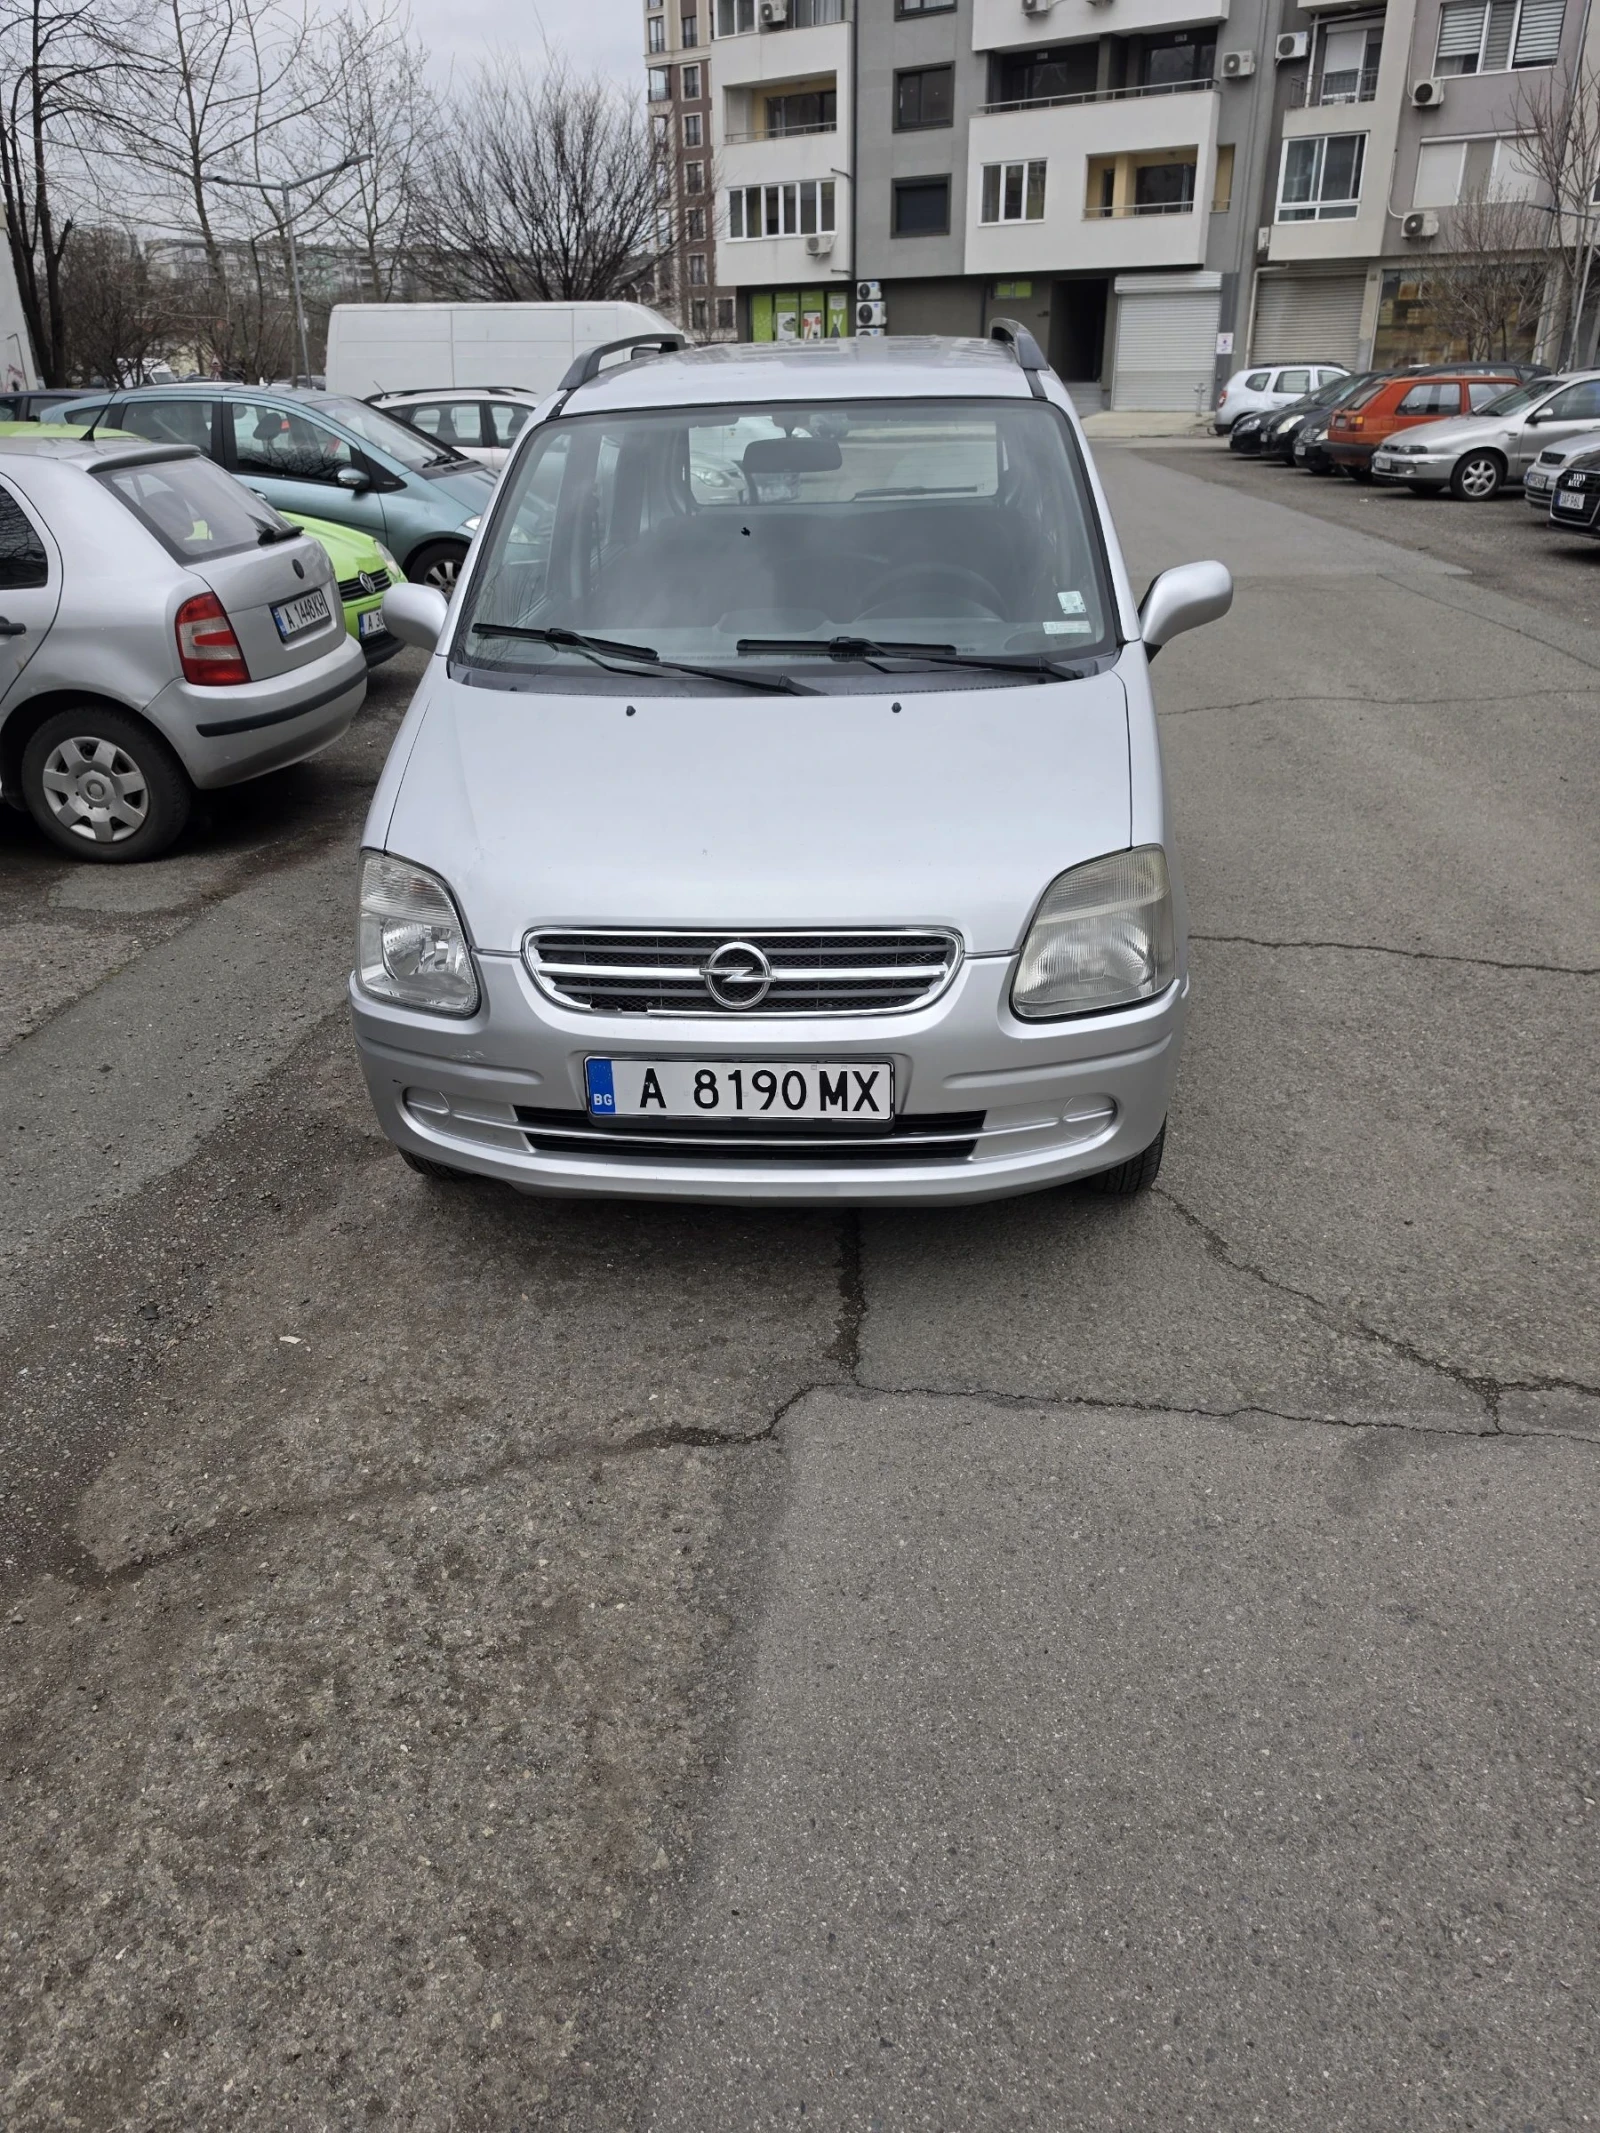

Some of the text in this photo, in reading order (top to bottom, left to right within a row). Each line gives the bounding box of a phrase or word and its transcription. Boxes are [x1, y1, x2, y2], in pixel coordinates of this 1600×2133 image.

[285, 608, 296, 629] A
[368, 614, 374, 631] A
[594, 1067, 880, 1112] BG A 8190 MX
